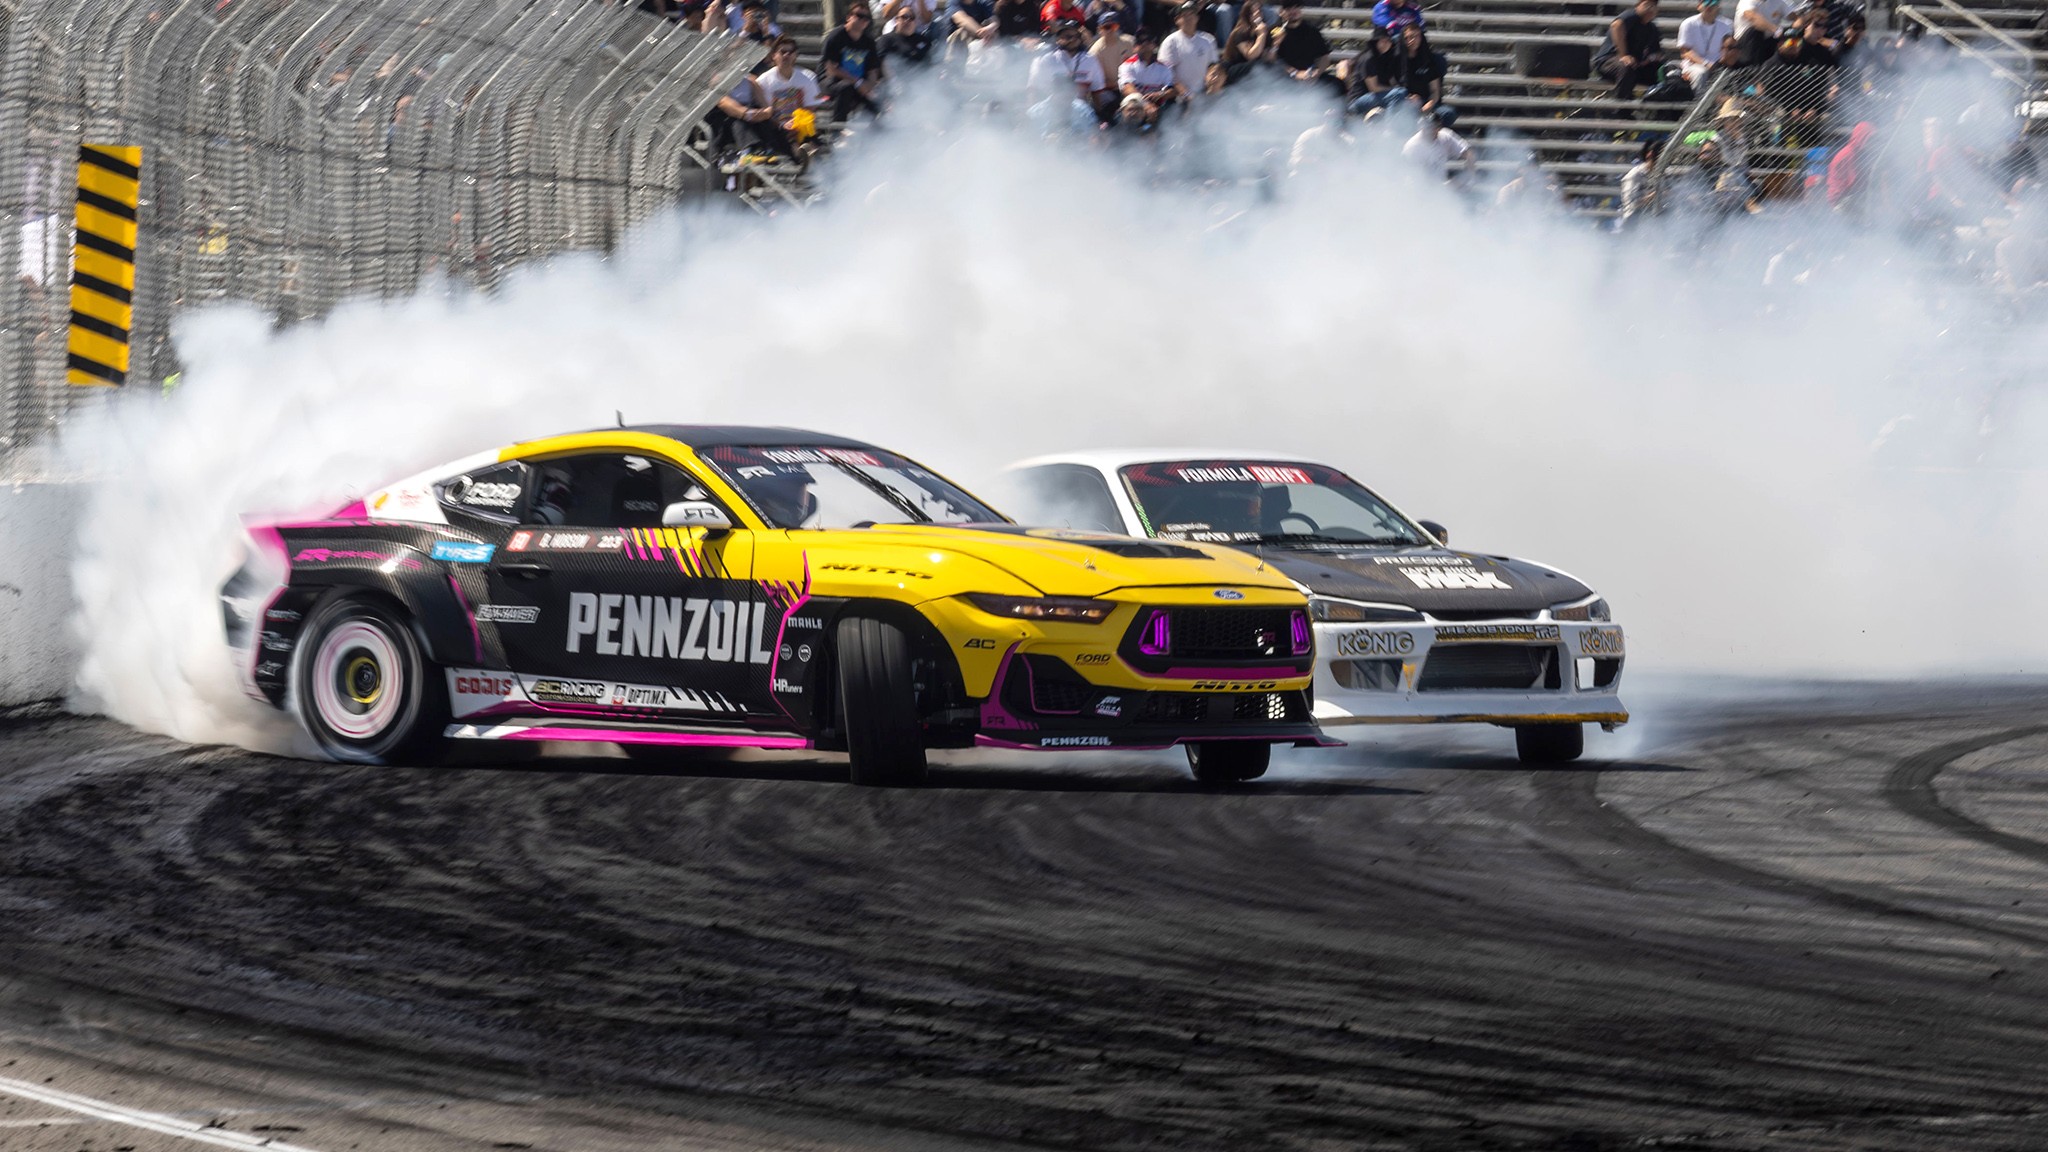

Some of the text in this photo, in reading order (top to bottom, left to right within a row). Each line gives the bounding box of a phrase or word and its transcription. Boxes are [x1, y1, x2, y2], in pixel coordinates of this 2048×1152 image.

[1176, 466, 1309, 484] FORMULA DRIFT
[468, 482, 522, 500] FORD
[1373, 556, 1473, 567] PRECISION
[820, 563, 933, 580] NITTO
[1402, 571, 1513, 590] MAX
[565, 591, 773, 665] PENNZOIL
[787, 616, 823, 629] MAHLE
[1435, 625, 1535, 634] TREADSTONE
[963, 638, 996, 650] BC
[1337, 628, 1415, 656] KÖNIG
[1580, 628, 1624, 654] KÖNIG
[1076, 653, 1111, 663] FORD
[559, 681, 606, 699] RACING
[1192, 681, 1277, 690] NITTO
[627, 687, 668, 706] OPTIMA
[1041, 736, 1113, 747] PENNZOIL
